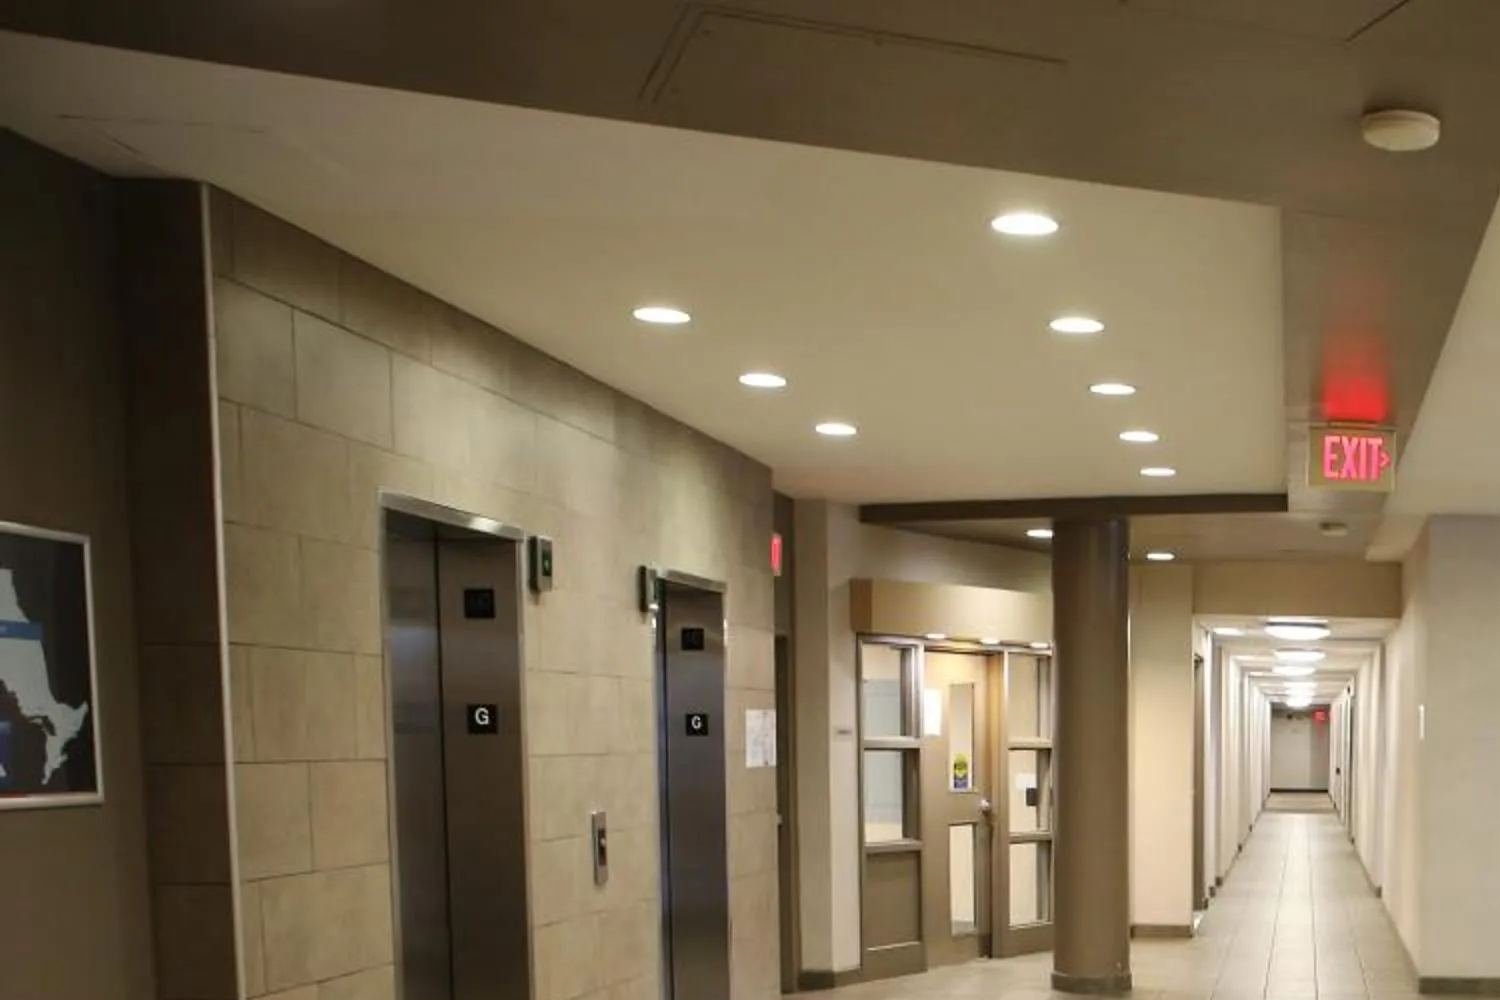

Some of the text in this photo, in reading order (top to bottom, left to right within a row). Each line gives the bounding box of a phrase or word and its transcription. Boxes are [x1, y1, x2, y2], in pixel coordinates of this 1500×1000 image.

[1324, 435, 1383, 480] EXIT
[475, 707, 490, 725] G
[691, 715, 702, 730] G
